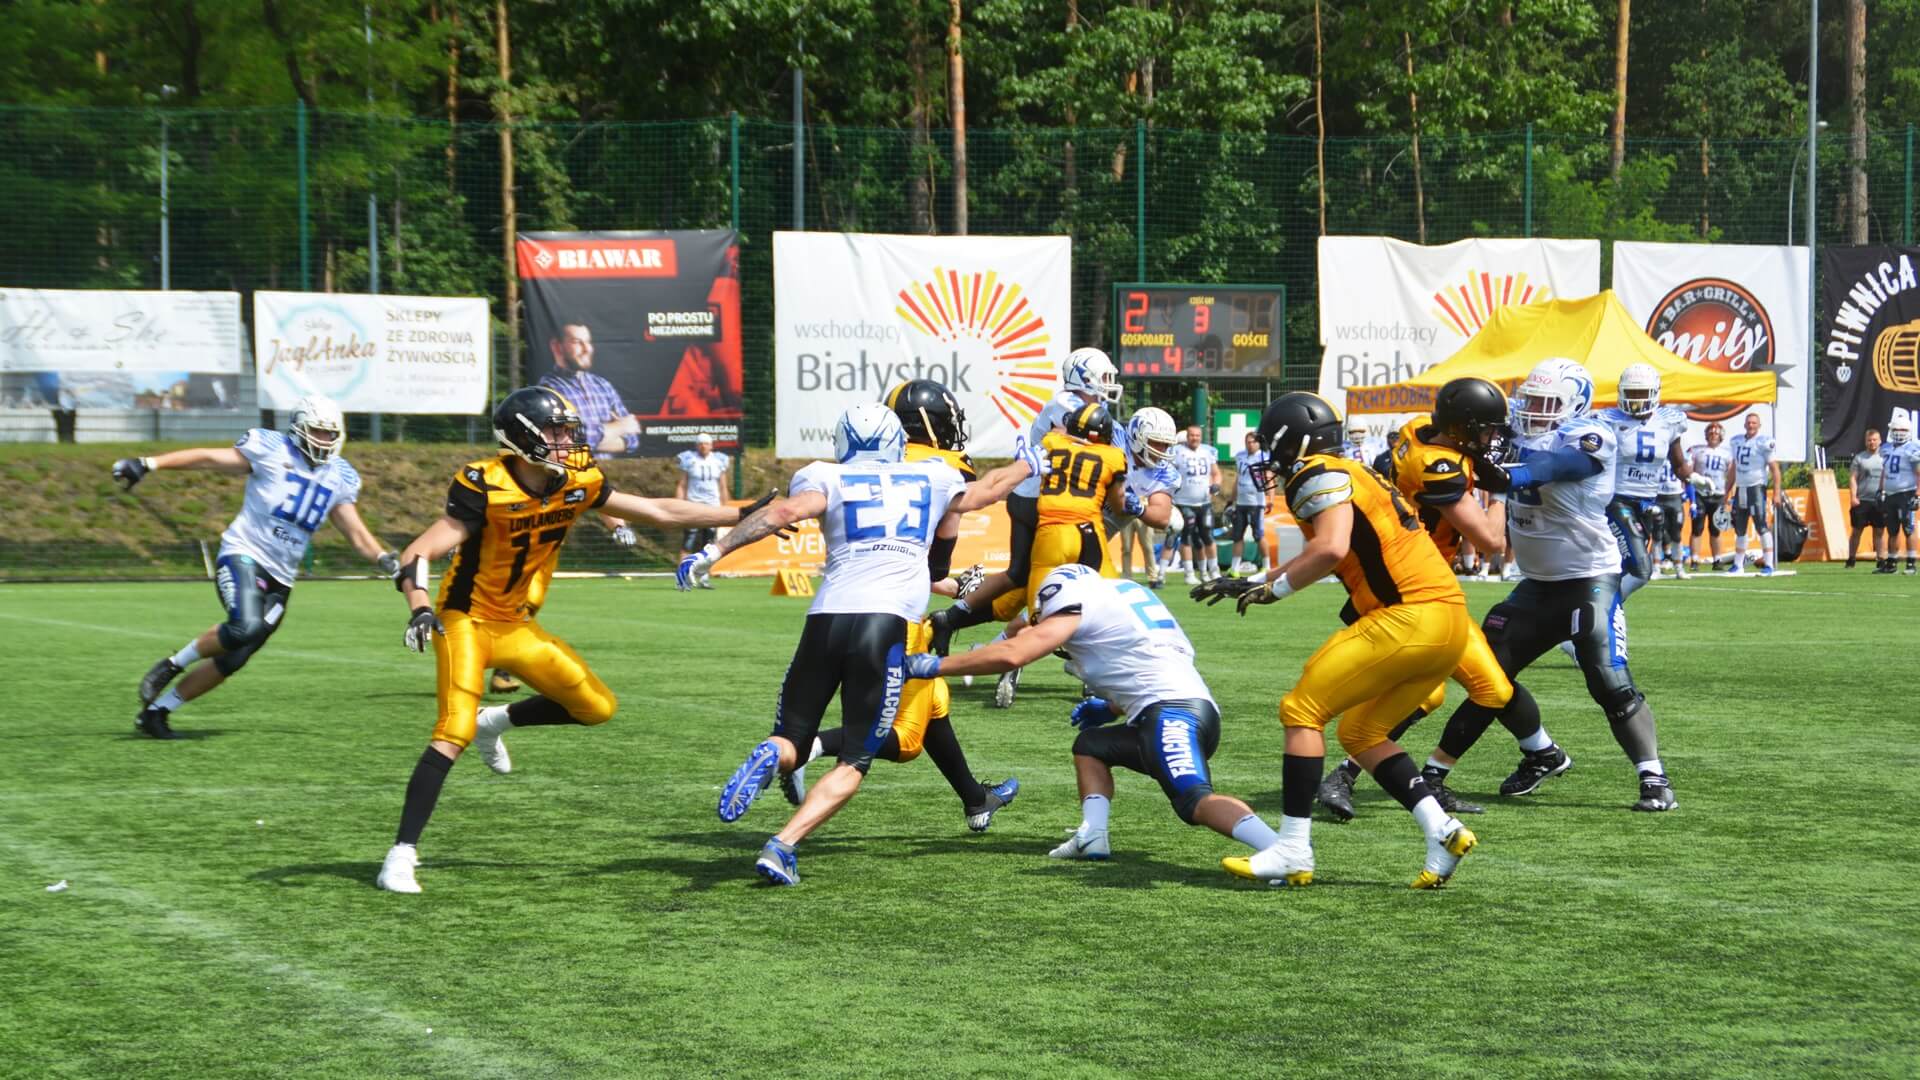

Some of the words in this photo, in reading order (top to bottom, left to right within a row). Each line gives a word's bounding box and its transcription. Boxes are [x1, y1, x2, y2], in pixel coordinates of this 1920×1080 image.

[557, 249, 663, 268] BIAWAR
[386, 309, 442, 322] SKLEPY
[1125, 292, 1149, 332] 2
[1663, 290, 1697, 321] BAR
[1704, 286, 1749, 315] GRILL
[1827, 254, 1917, 360] PIWNICA
[648, 312, 666, 324] PO
[667, 312, 713, 324] PROSTU
[794, 319, 901, 344] wschodzący
[1194, 306, 1210, 334] 3
[387, 330, 402, 342] ZE
[1121, 333, 1174, 346] GOSPODARZE
[1232, 330, 1269, 346] GOŚCIE
[1335, 319, 1438, 346] wschodzący
[1163, 347, 1183, 374] 4
[797, 350, 972, 400] Białystok
[1635, 431, 1656, 463] 6
[1736, 446, 1751, 465] 12
[1041, 449, 1103, 498] 80
[272, 472, 333, 533] 38
[839, 474, 932, 545] 23
[510, 507, 576, 532] LOWLANDERS
[503, 526, 568, 594] 17
[787, 572, 809, 593] 40
[875, 664, 903, 738] FALCONS
[1161, 718, 1197, 779] FALCONS
